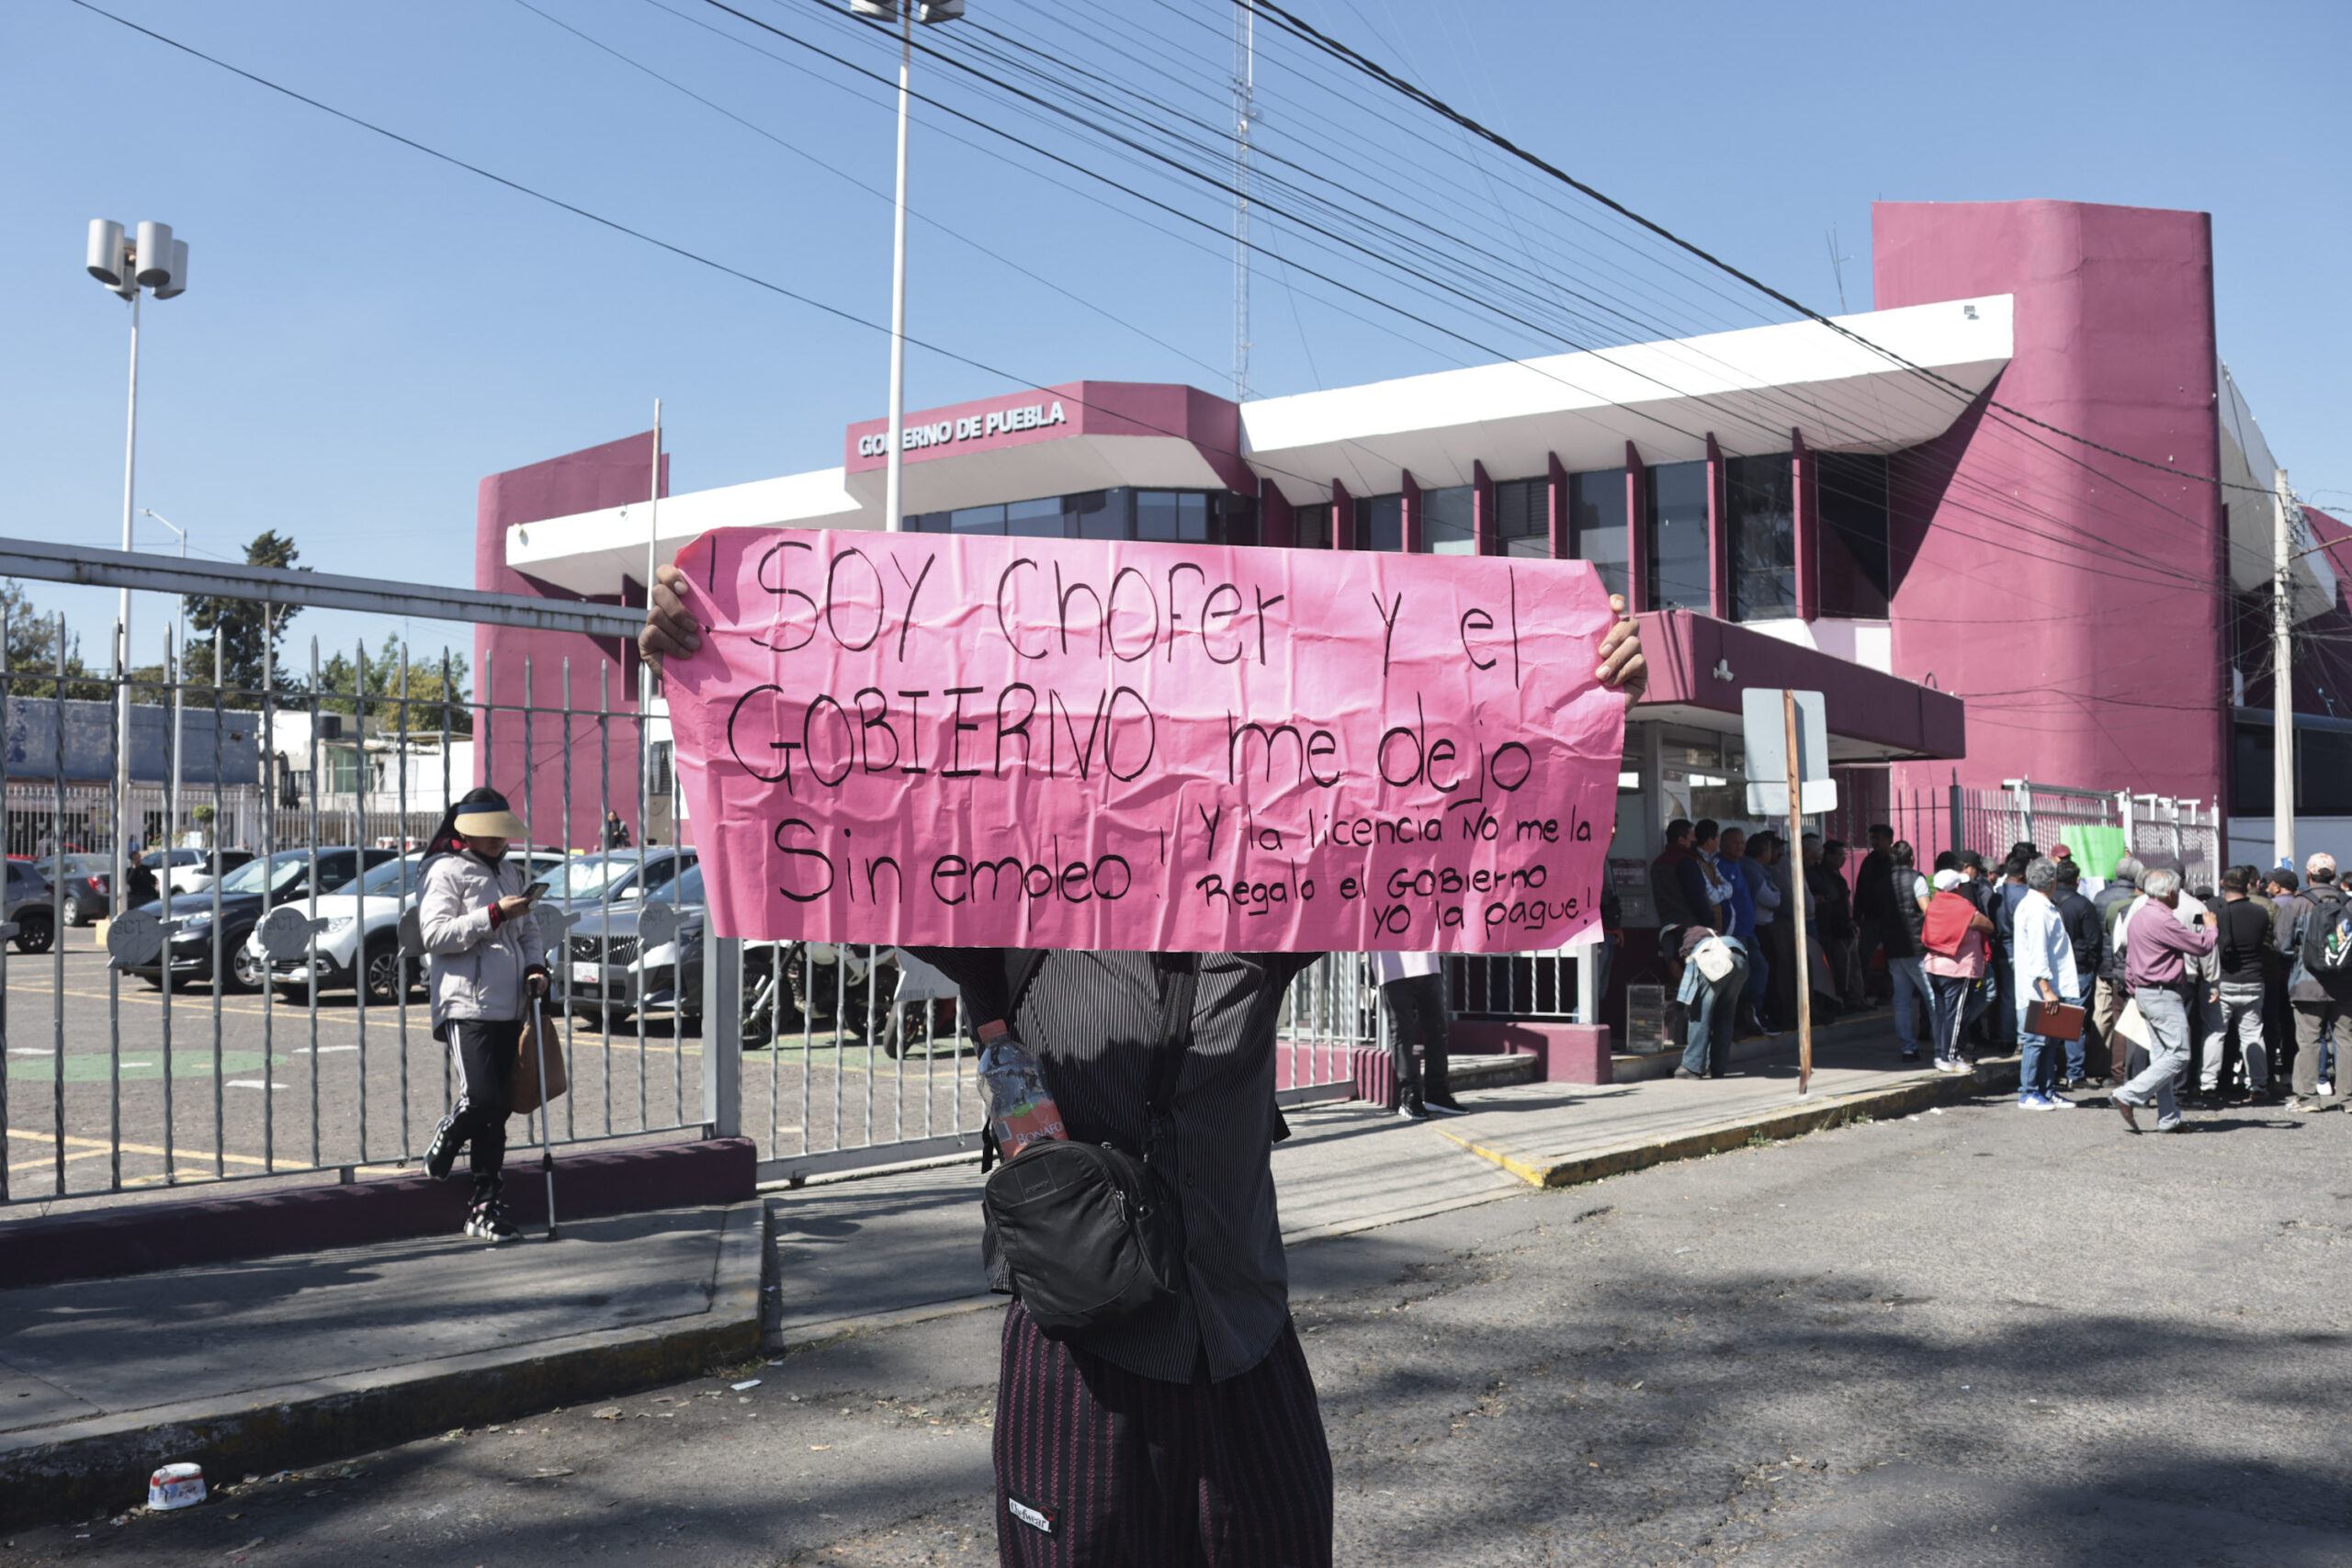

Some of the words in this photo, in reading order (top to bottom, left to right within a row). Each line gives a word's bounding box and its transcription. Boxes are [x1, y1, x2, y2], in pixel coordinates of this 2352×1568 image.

[858, 423, 953, 457] GOERNO
[956, 416, 983, 440] DE
[986, 401, 1067, 434] PUEBLA
[1461, 565, 1519, 689] el
[728, 682, 1155, 795] GOBIERNO
[1227, 709, 1340, 788] me
[1378, 691, 1532, 811] dejo
[1248, 804, 1283, 851] la
[1308, 806, 1442, 847] licencia
[1516, 818, 1559, 842] me
[1569, 805, 1591, 842] la
[775, 818, 902, 905] Sin
[1195, 857, 1315, 915] Regalo
[1340, 863, 1366, 900] el
[1435, 900, 1464, 931] la
